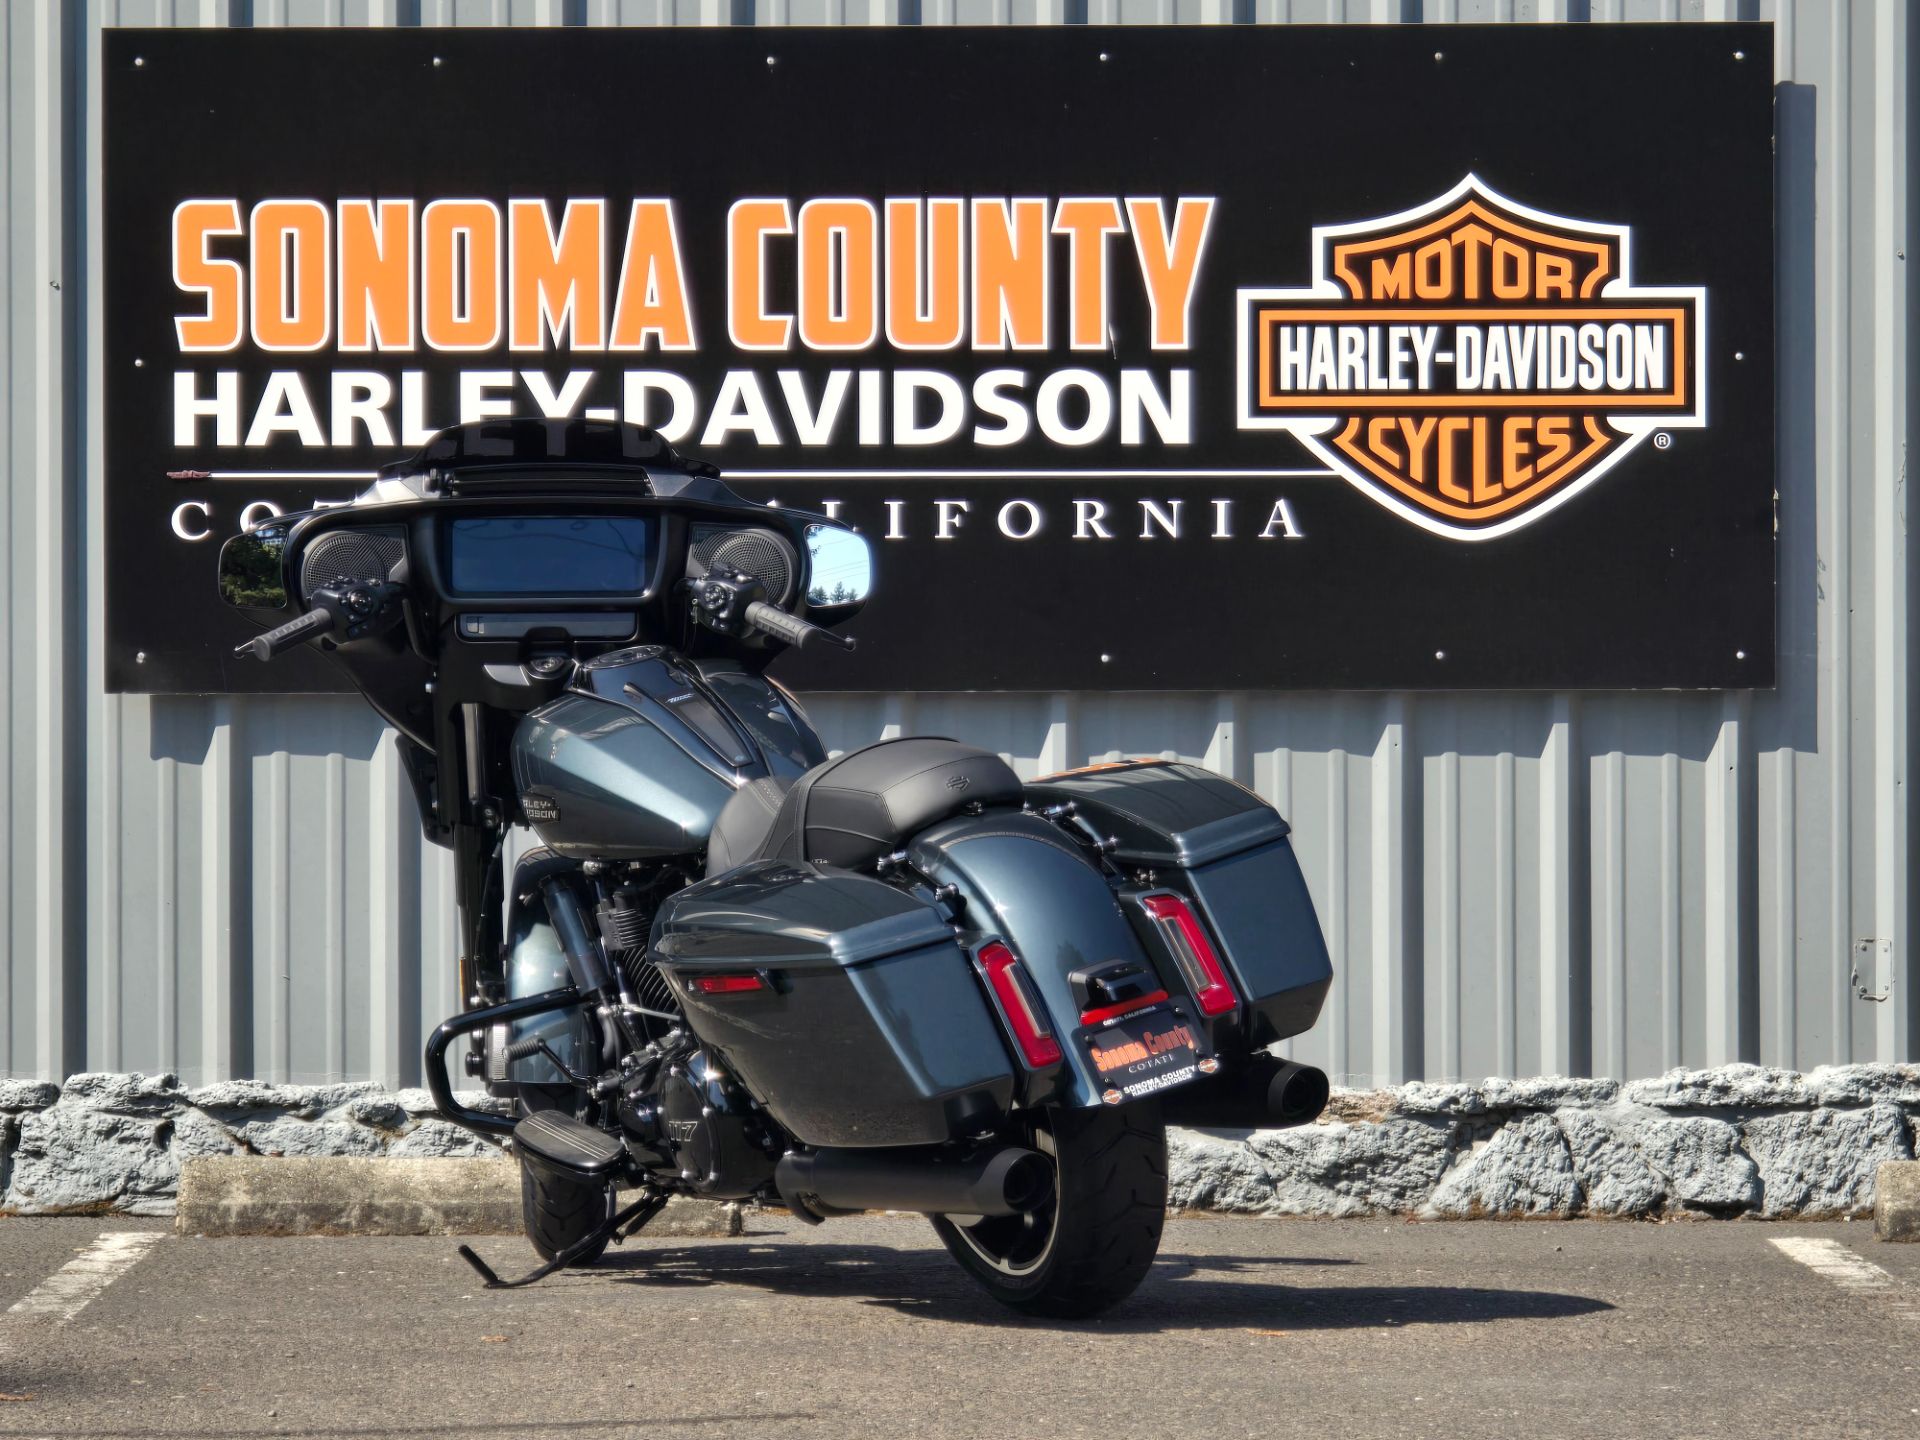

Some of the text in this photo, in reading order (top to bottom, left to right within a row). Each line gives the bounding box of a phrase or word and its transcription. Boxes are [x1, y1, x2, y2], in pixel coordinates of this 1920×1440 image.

[172, 196, 1217, 353] SONOMA COUNTY
[1371, 222, 1574, 300] MOTOR
[1280, 324, 1665, 391] HARLEY-DAVIDSON
[1368, 416, 1573, 503] CYCLES
[1090, 1025, 1194, 1073] Sonoma County
[1128, 1054, 1175, 1073] COTATI
[1123, 1077, 1161, 1094] SONOMA
[1161, 1065, 1196, 1081] COUNTY
[668, 1120, 698, 1142] 117
